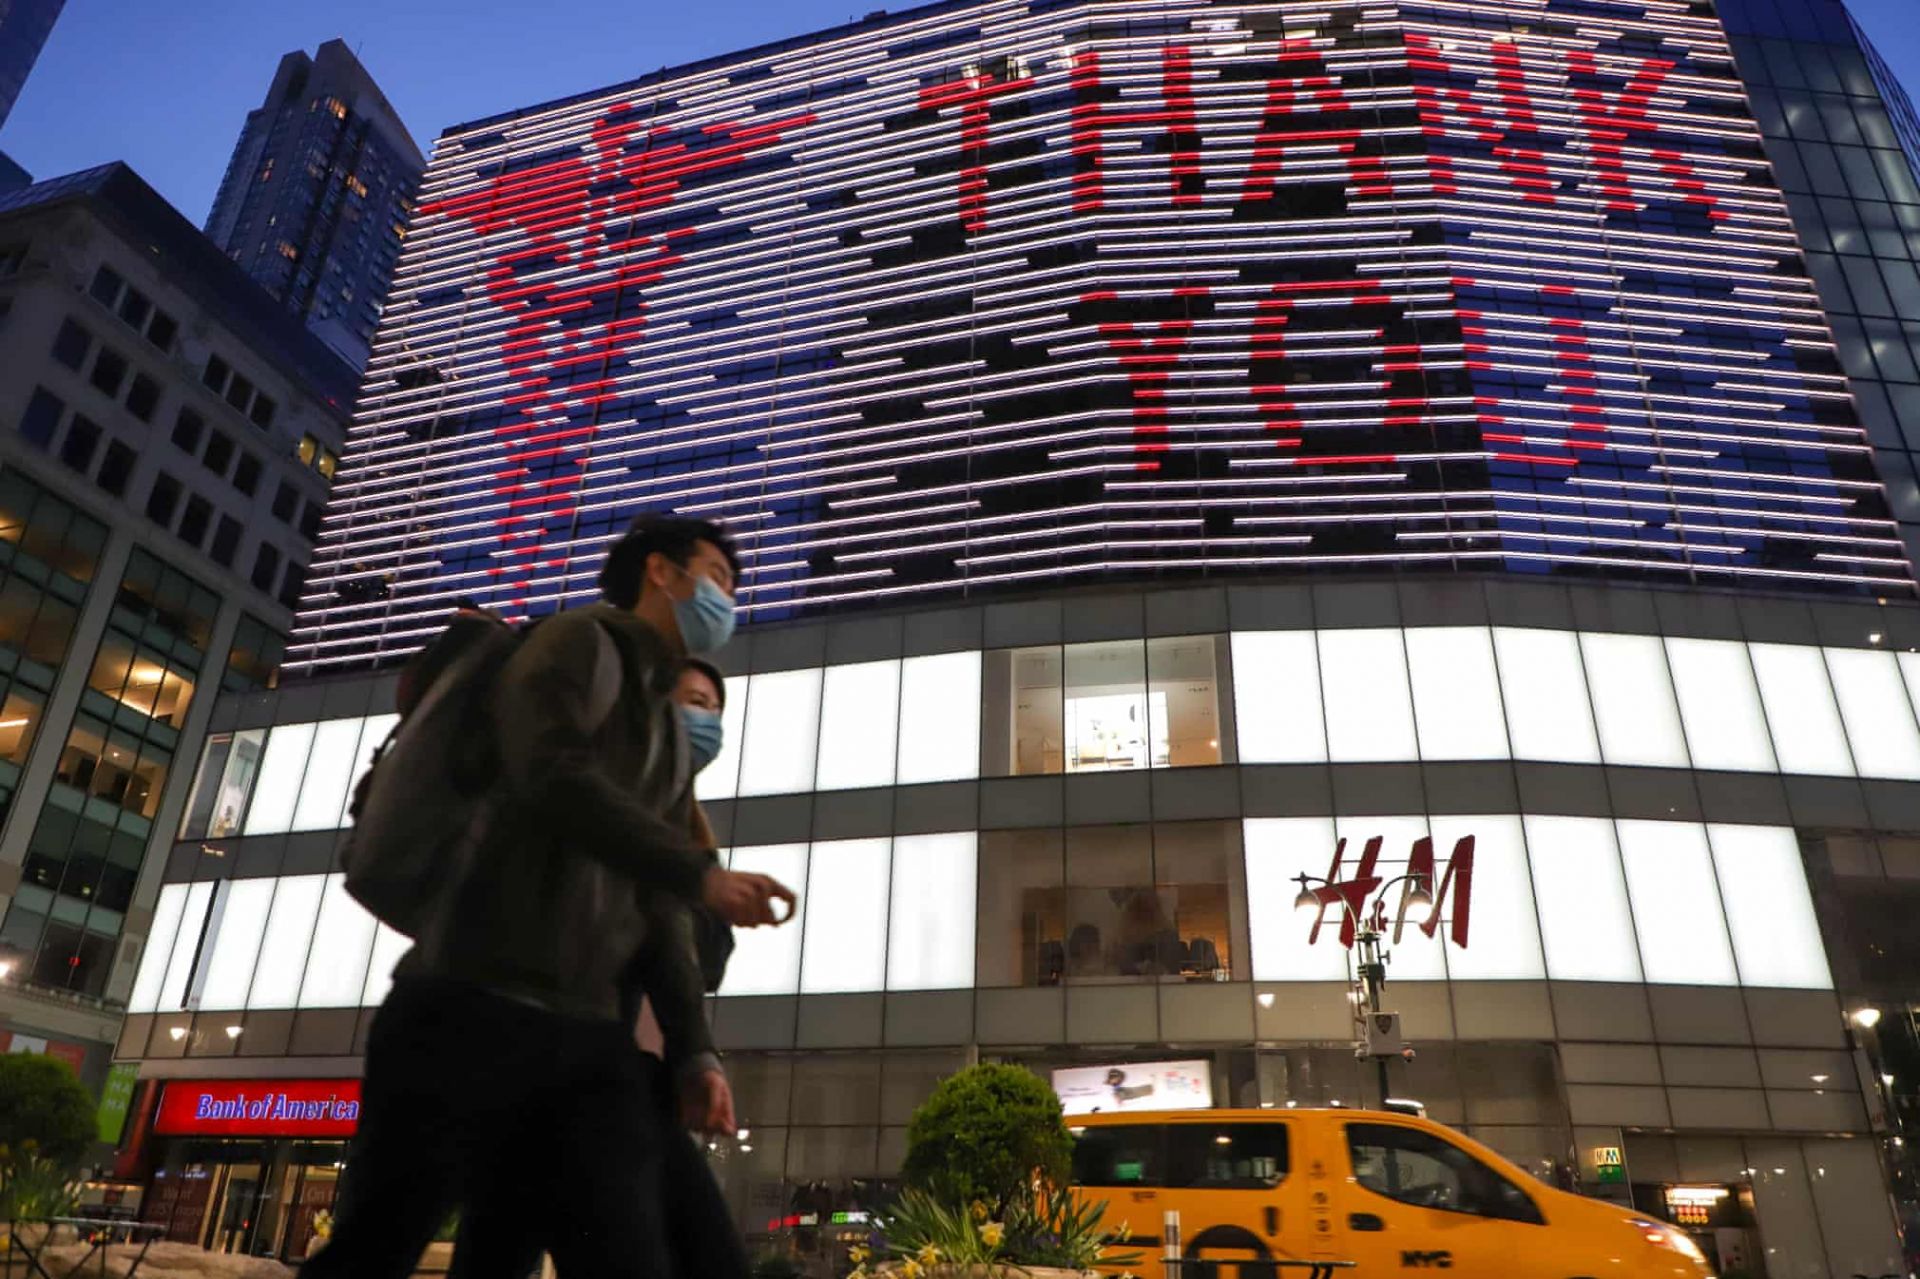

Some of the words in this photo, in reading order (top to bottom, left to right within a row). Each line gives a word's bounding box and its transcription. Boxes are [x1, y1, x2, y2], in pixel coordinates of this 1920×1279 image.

[917, 33, 1731, 231] THANK
[1079, 277, 1607, 470] YOU
[195, 1093, 247, 1120] Bank
[249, 1093, 275, 1120] of
[271, 1093, 360, 1120] America
[1400, 1250, 1452, 1268] NYC
